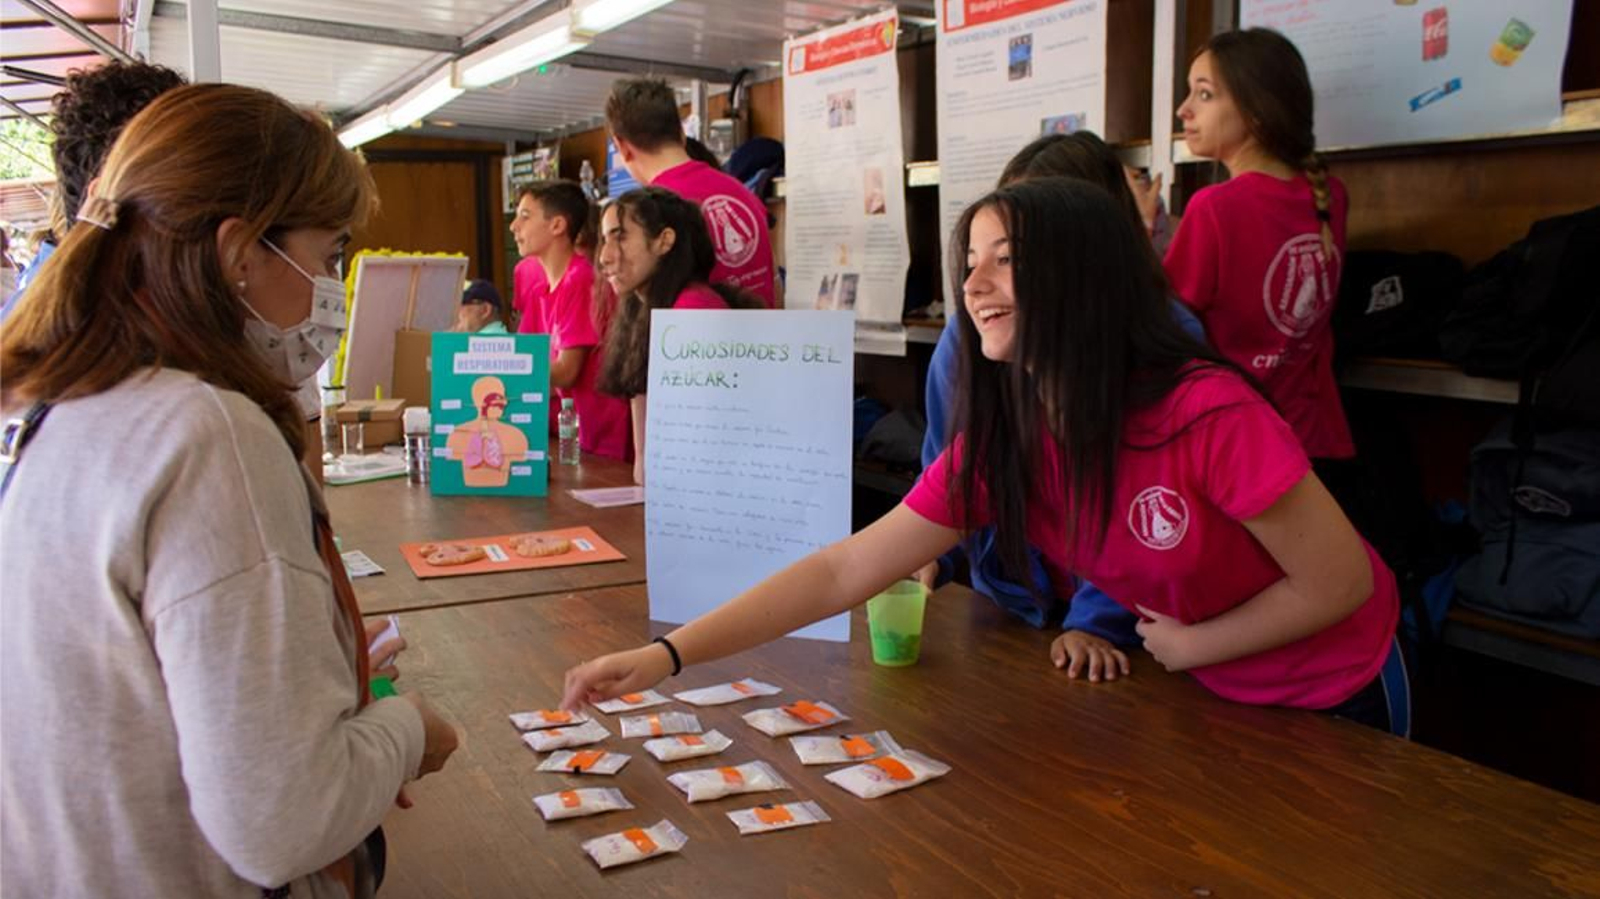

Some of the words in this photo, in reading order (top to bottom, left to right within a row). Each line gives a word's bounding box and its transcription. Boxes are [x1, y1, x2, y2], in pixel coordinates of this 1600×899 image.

[471, 341, 512, 352] SISTEMA
[660, 324, 790, 362] CURIOSIDADES
[801, 343, 842, 364] DEL
[457, 359, 527, 371] RESPIRATORIO
[660, 366, 739, 389] AZÚCAR:
